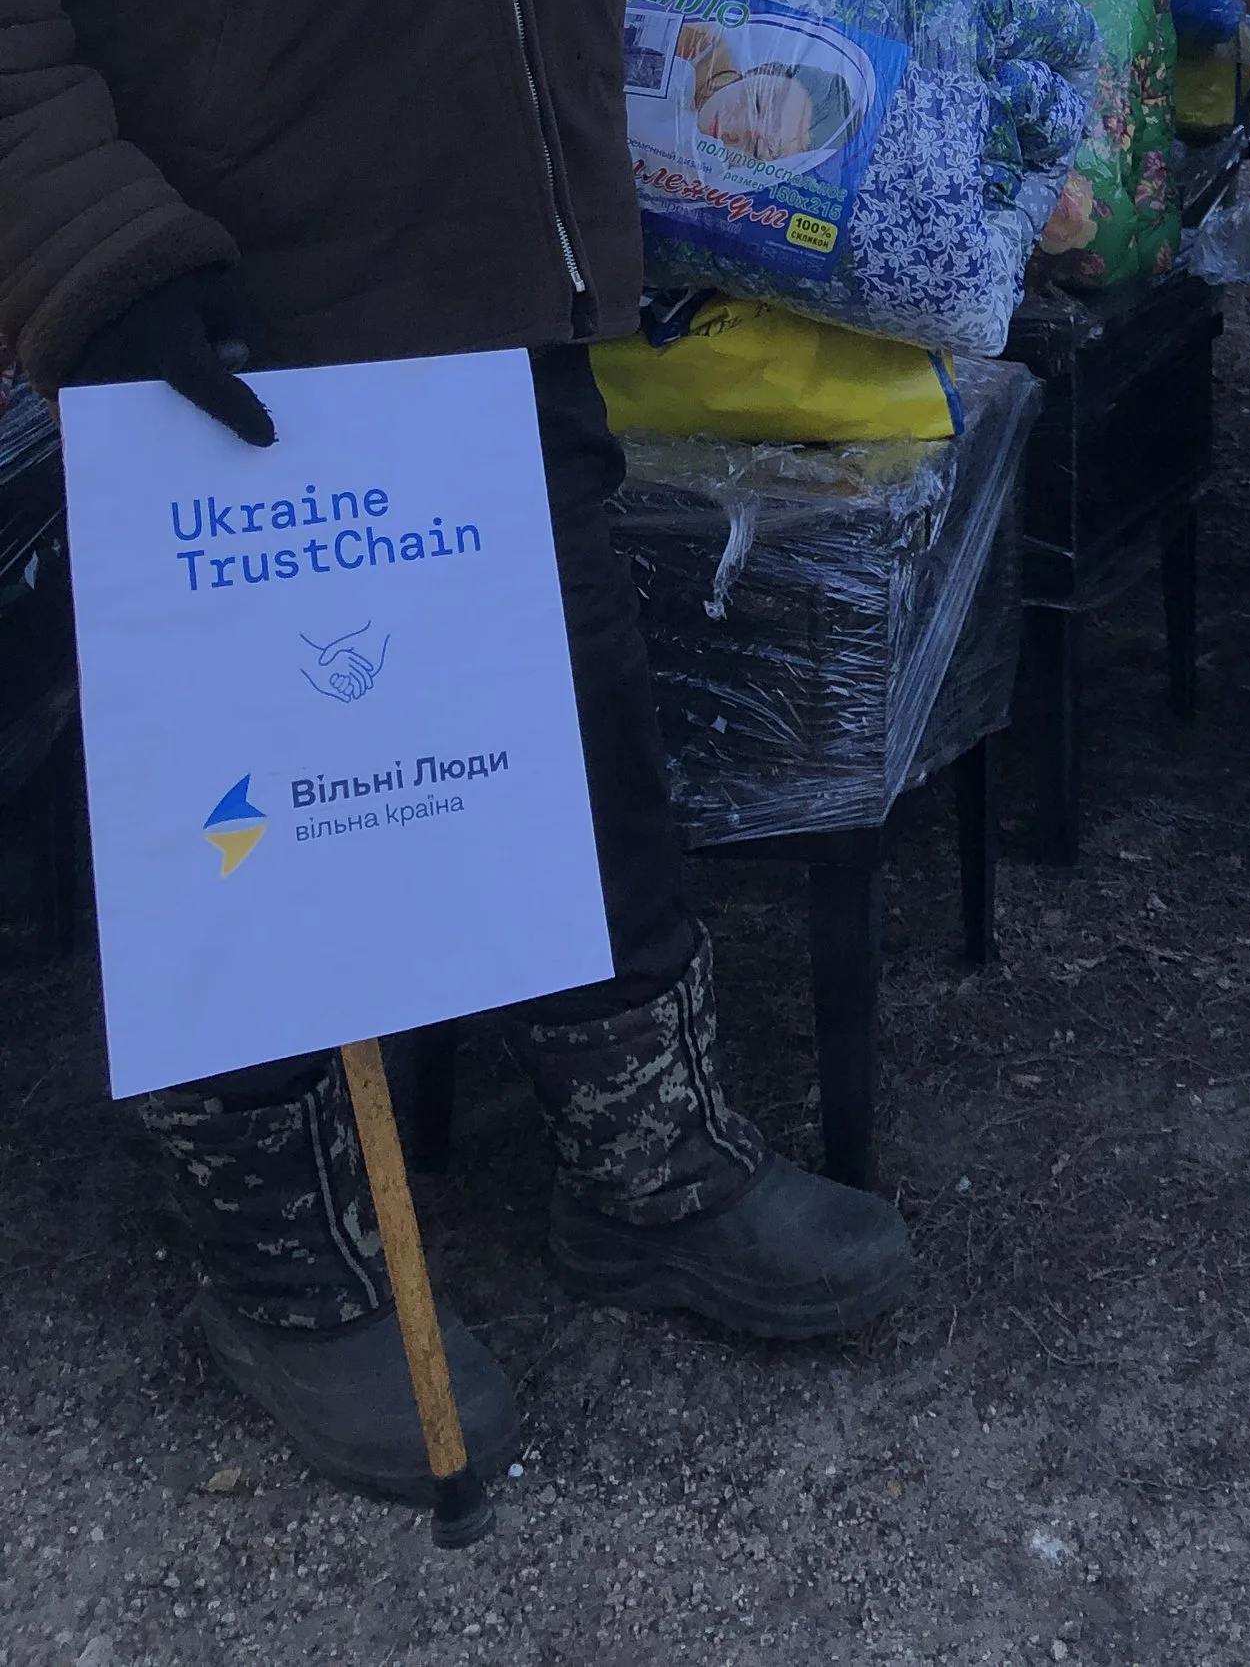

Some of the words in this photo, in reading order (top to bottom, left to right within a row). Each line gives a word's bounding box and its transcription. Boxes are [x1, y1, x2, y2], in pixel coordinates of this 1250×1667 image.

[794, 216, 832, 239] 100%
[171, 484, 389, 541] Ukraine
[176, 517, 481, 590] TrustChain
[291, 760, 404, 809] Вільні
[413, 750, 509, 787] Люди
[295, 812, 380, 842] вільна
[385, 794, 465, 827] країна
